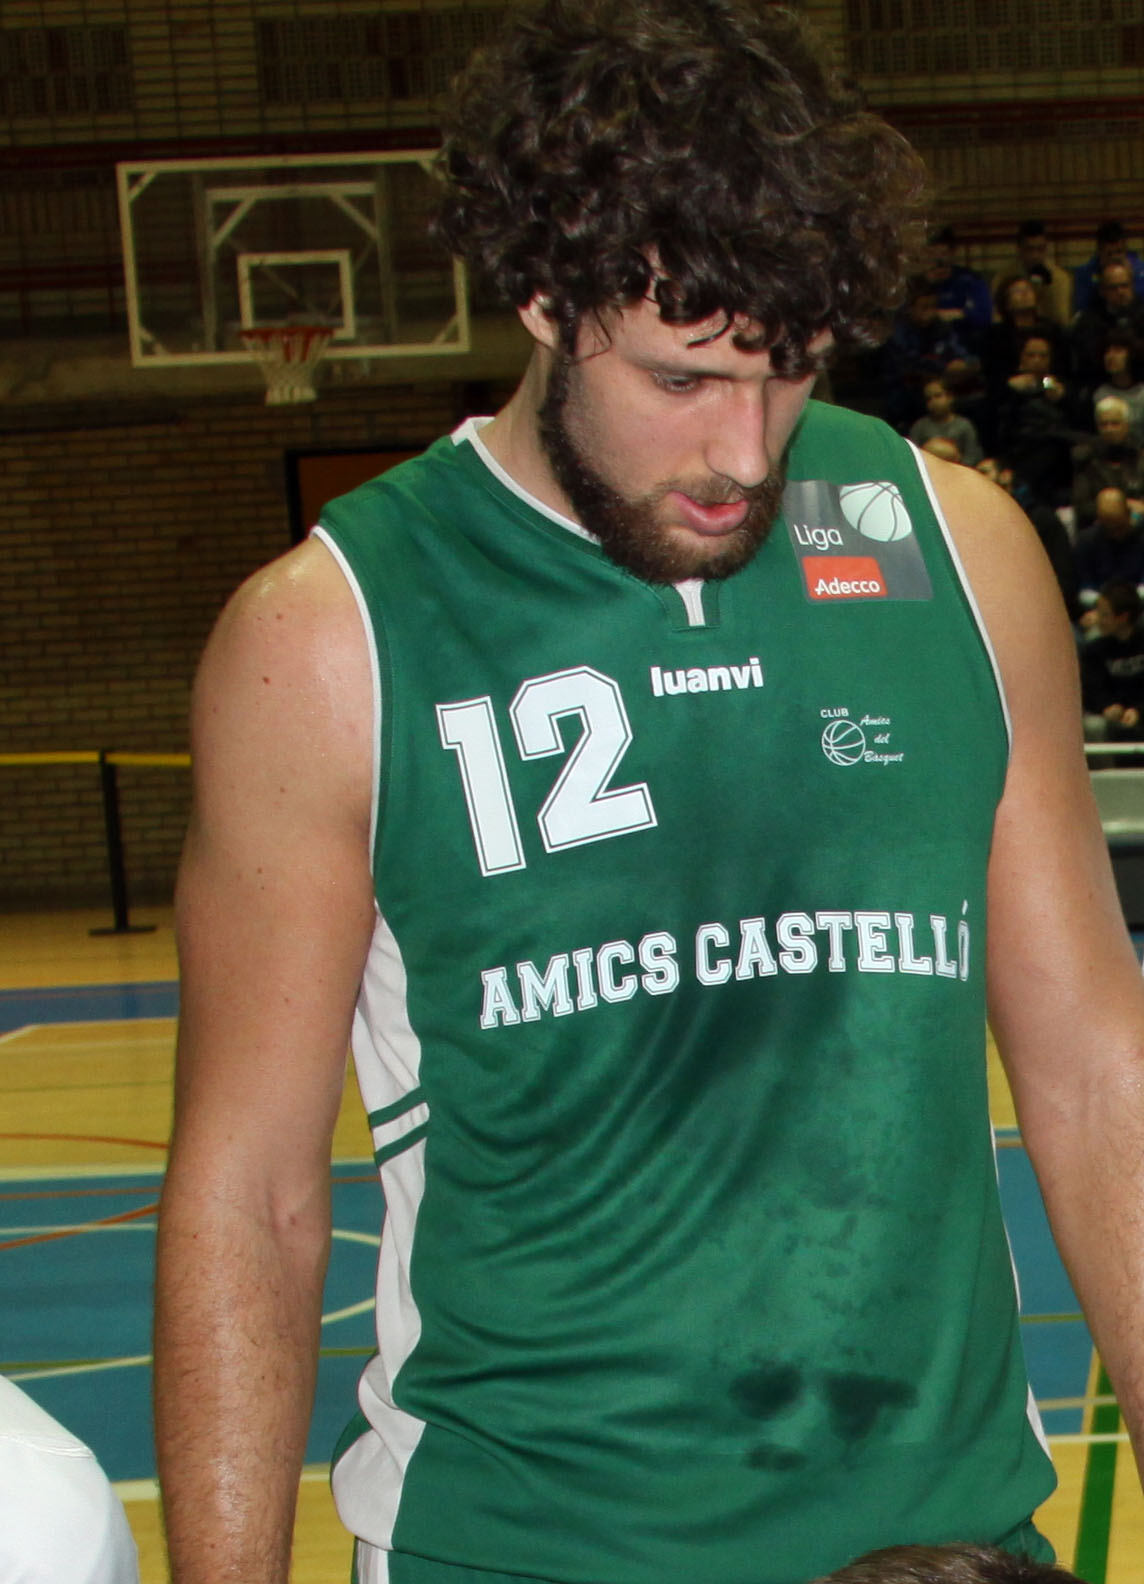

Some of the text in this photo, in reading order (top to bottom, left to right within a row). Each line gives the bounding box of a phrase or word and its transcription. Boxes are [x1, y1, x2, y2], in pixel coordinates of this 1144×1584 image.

[793, 524, 844, 551] Liga
[814, 577, 881, 596] Adecco
[820, 707, 849, 719] CLUB
[873, 732, 891, 745] del
[435, 666, 658, 877] 12
[479, 899, 971, 1030] AMICS CASTELLÓ
